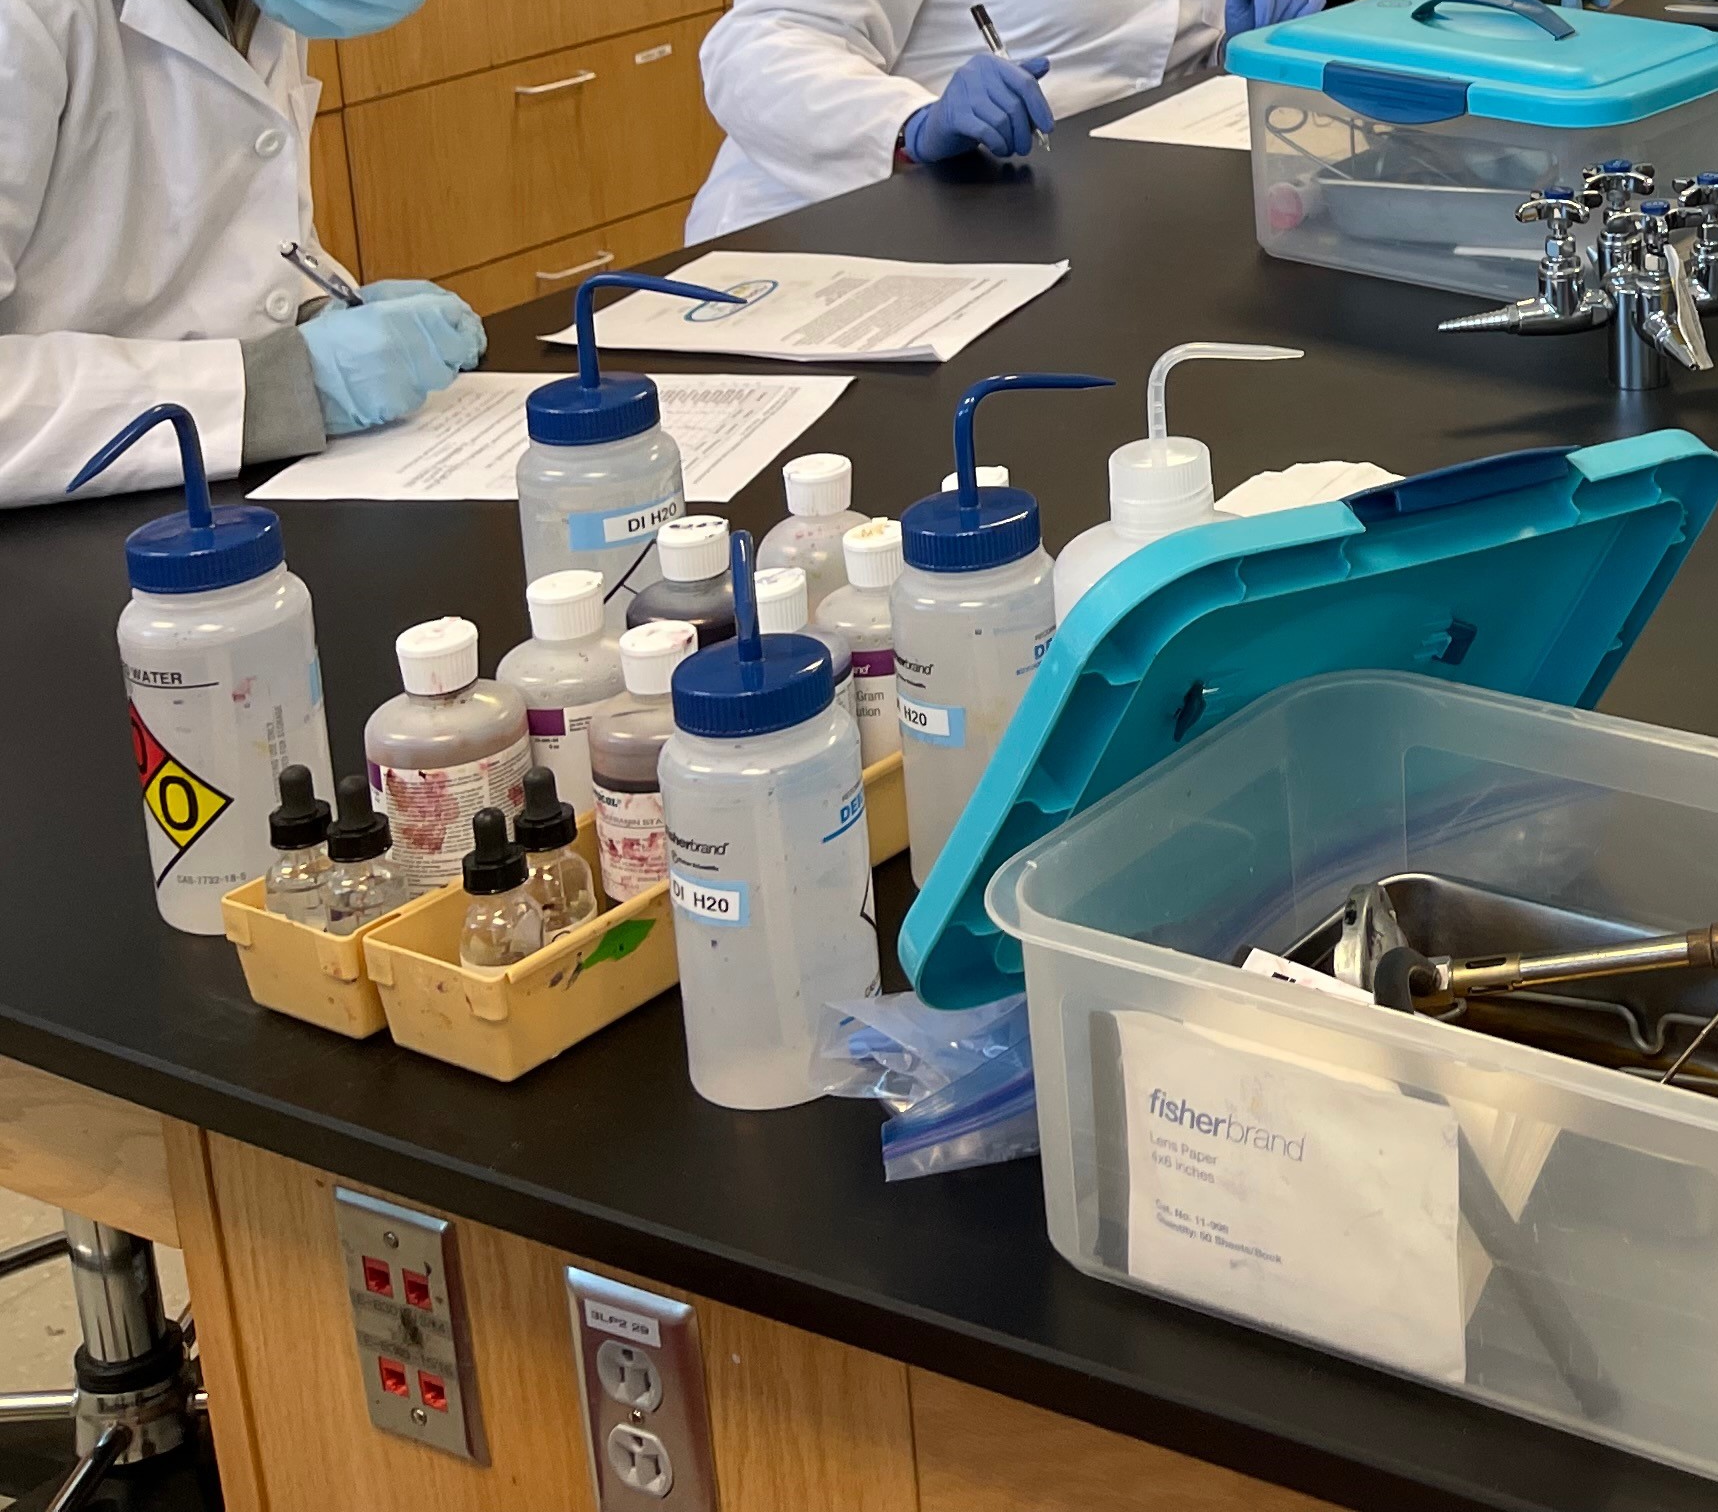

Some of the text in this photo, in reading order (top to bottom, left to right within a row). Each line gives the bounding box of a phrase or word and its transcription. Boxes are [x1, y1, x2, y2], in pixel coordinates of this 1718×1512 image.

[628, 517, 645, 532] DI
[132, 669, 183, 685] WATER
[856, 691, 884, 702] Gram
[672, 880, 685, 901] DI
[1149, 1088, 1307, 1162] fisherbrand
[1150, 1130, 1217, 1165] Lens Paper
[1175, 1159, 1215, 1184] inches
